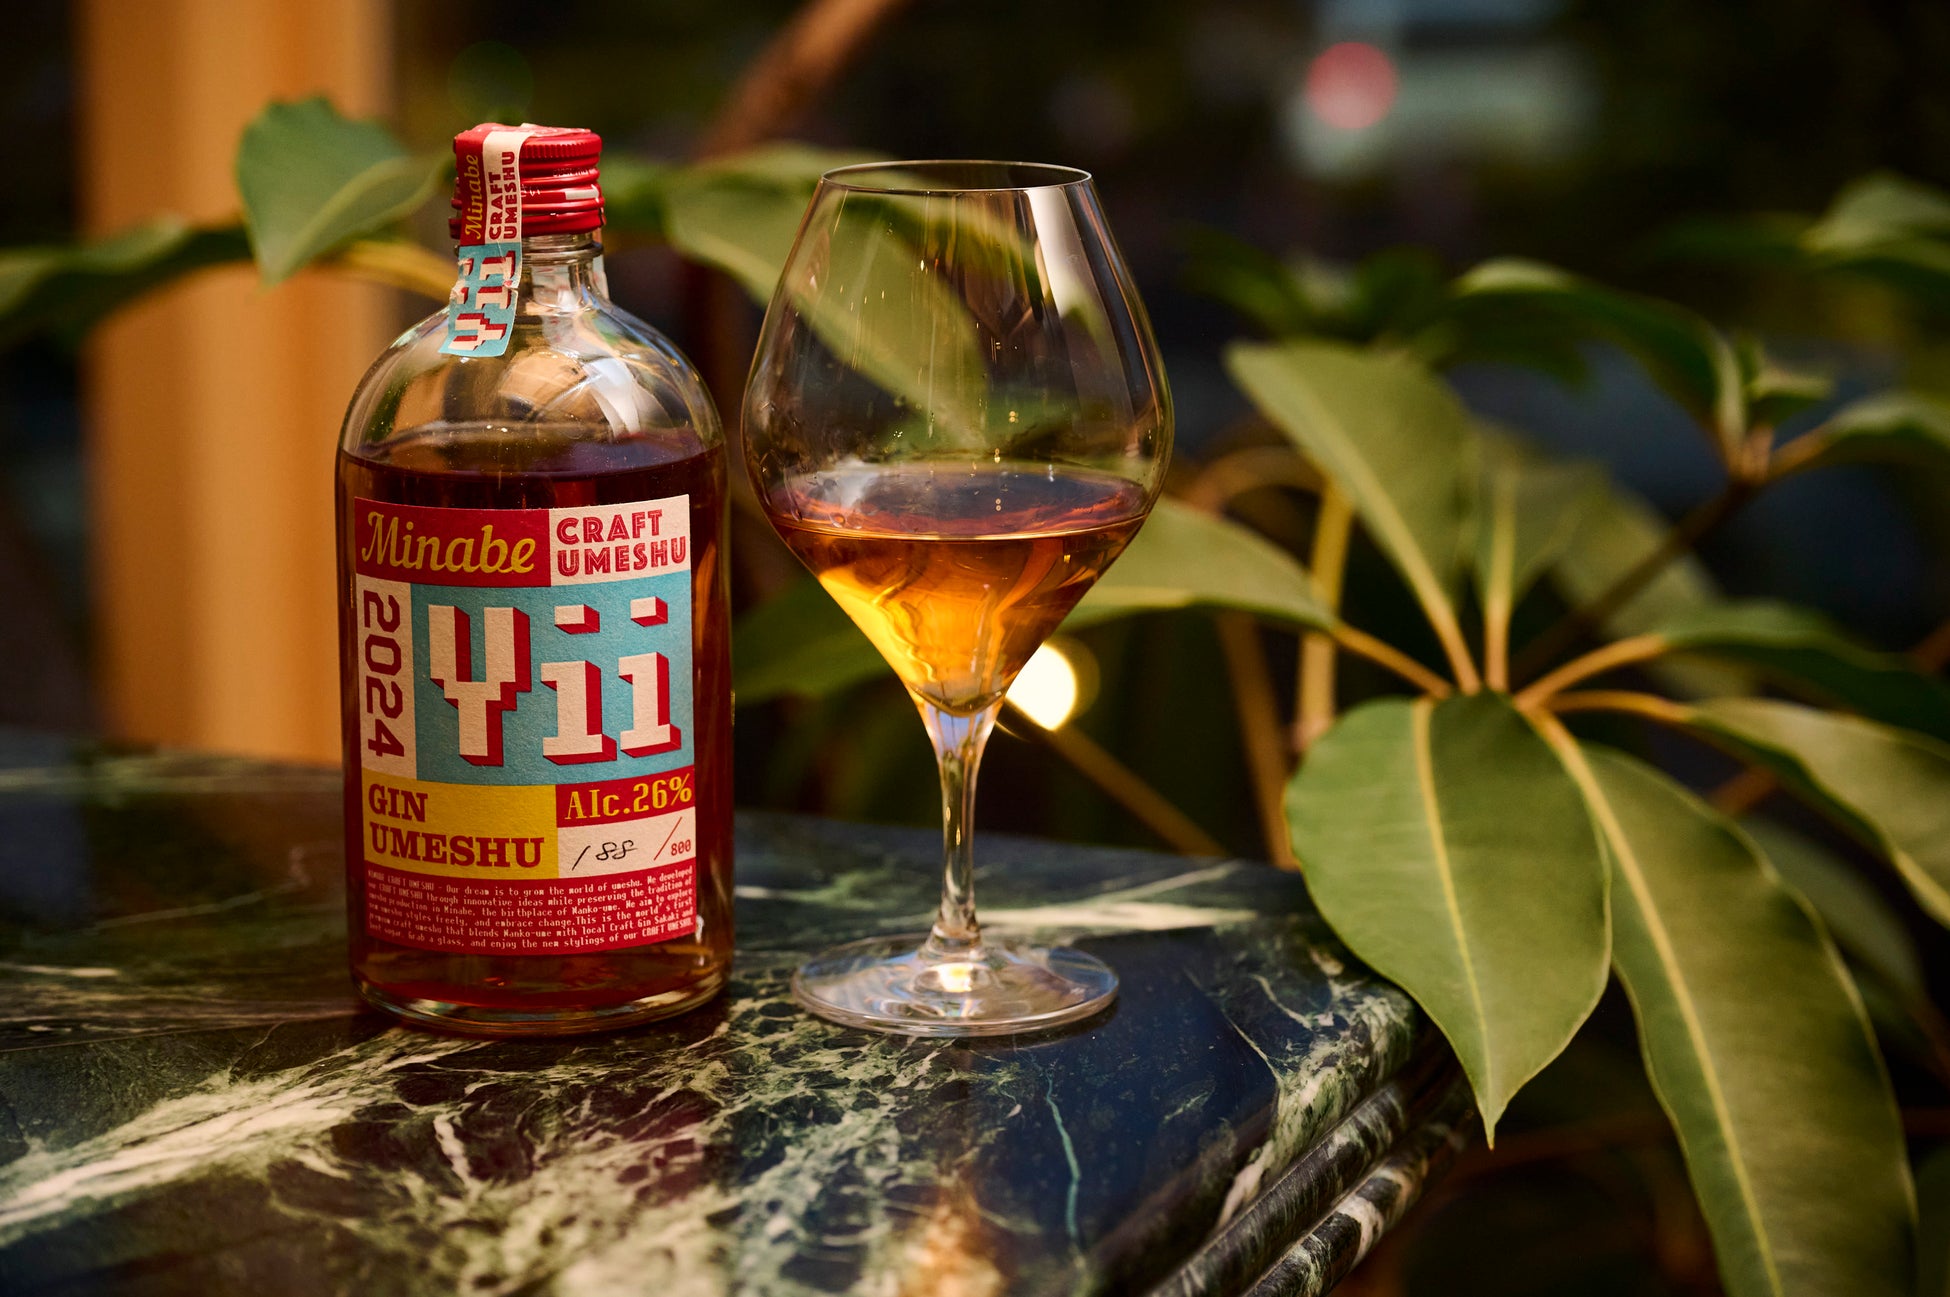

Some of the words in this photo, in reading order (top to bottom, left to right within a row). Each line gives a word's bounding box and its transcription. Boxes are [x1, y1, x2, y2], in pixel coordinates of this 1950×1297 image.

[465, 154, 483, 240] Minabe
[488, 171, 503, 240] CRAFT
[502, 151, 518, 240] UMESHU
[361, 510, 537, 575] Minabe
[556, 509, 663, 545] CRAFT
[557, 536, 687, 577] UMESHU
[363, 589, 405, 758] 2024
[428, 596, 682, 767] Yii
[368, 783, 428, 823] GIN
[369, 821, 545, 869] UMESHU
[399, 888, 422, 899] UMESHU
[427, 892, 458, 905] through
[464, 895, 512, 906] innovative
[519, 897, 543, 907] ideas
[548, 896, 572, 906] while
[578, 890, 626, 906] preserving
[631, 888, 644, 898] the
[647, 879, 683, 895] tradition
[685, 876, 692, 886] of
[409, 880, 434, 891] UMESHU
[447, 884, 459, 894] Our
[465, 886, 489, 895] dream
[495, 886, 504, 896] is
[509, 887, 518, 896] to
[523, 889, 544, 897] grow
[550, 886, 564, 895] the
[569, 884, 593, 894] world
[598, 882, 607, 892] of
[647, 875, 656, 884] We
[659, 865, 692, 881] developed
[389, 898, 427, 912] production
[432, 902, 440, 912] in
[482, 907, 496, 917] the
[501, 907, 552, 919] birthplace
[557, 906, 567, 916] of
[625, 899, 635, 909] We
[639, 896, 652, 907] aim
[656, 894, 665, 903] to
[667, 888, 692, 903] explore
[393, 919, 411, 929] craft
[415, 923, 441, 934] umeshu
[446, 926, 463, 936] that
[469, 927, 499, 937] blends
[557, 927, 577, 937] with
[583, 923, 605, 935] local
[610, 920, 633, 932] Craft
[638, 917, 651, 928] Gin
[654, 909, 679, 925] Sakaki
[682, 906, 693, 918] and
[406, 910, 431, 922] styles
[475, 918, 490, 927] and
[495, 918, 533, 928] embrace
[602, 912, 612, 922] is
[617, 911, 631, 921] the
[674, 896, 692, 909] first
[408, 930, 425, 942] Grab
[470, 939, 486, 947] and
[490, 938, 517, 950] enjoy
[522, 939, 537, 948] the
[564, 935, 605, 948] stylings
[609, 933, 619, 942] of
[624, 932, 638, 941] our
[642, 924, 664, 937] CRAFT
